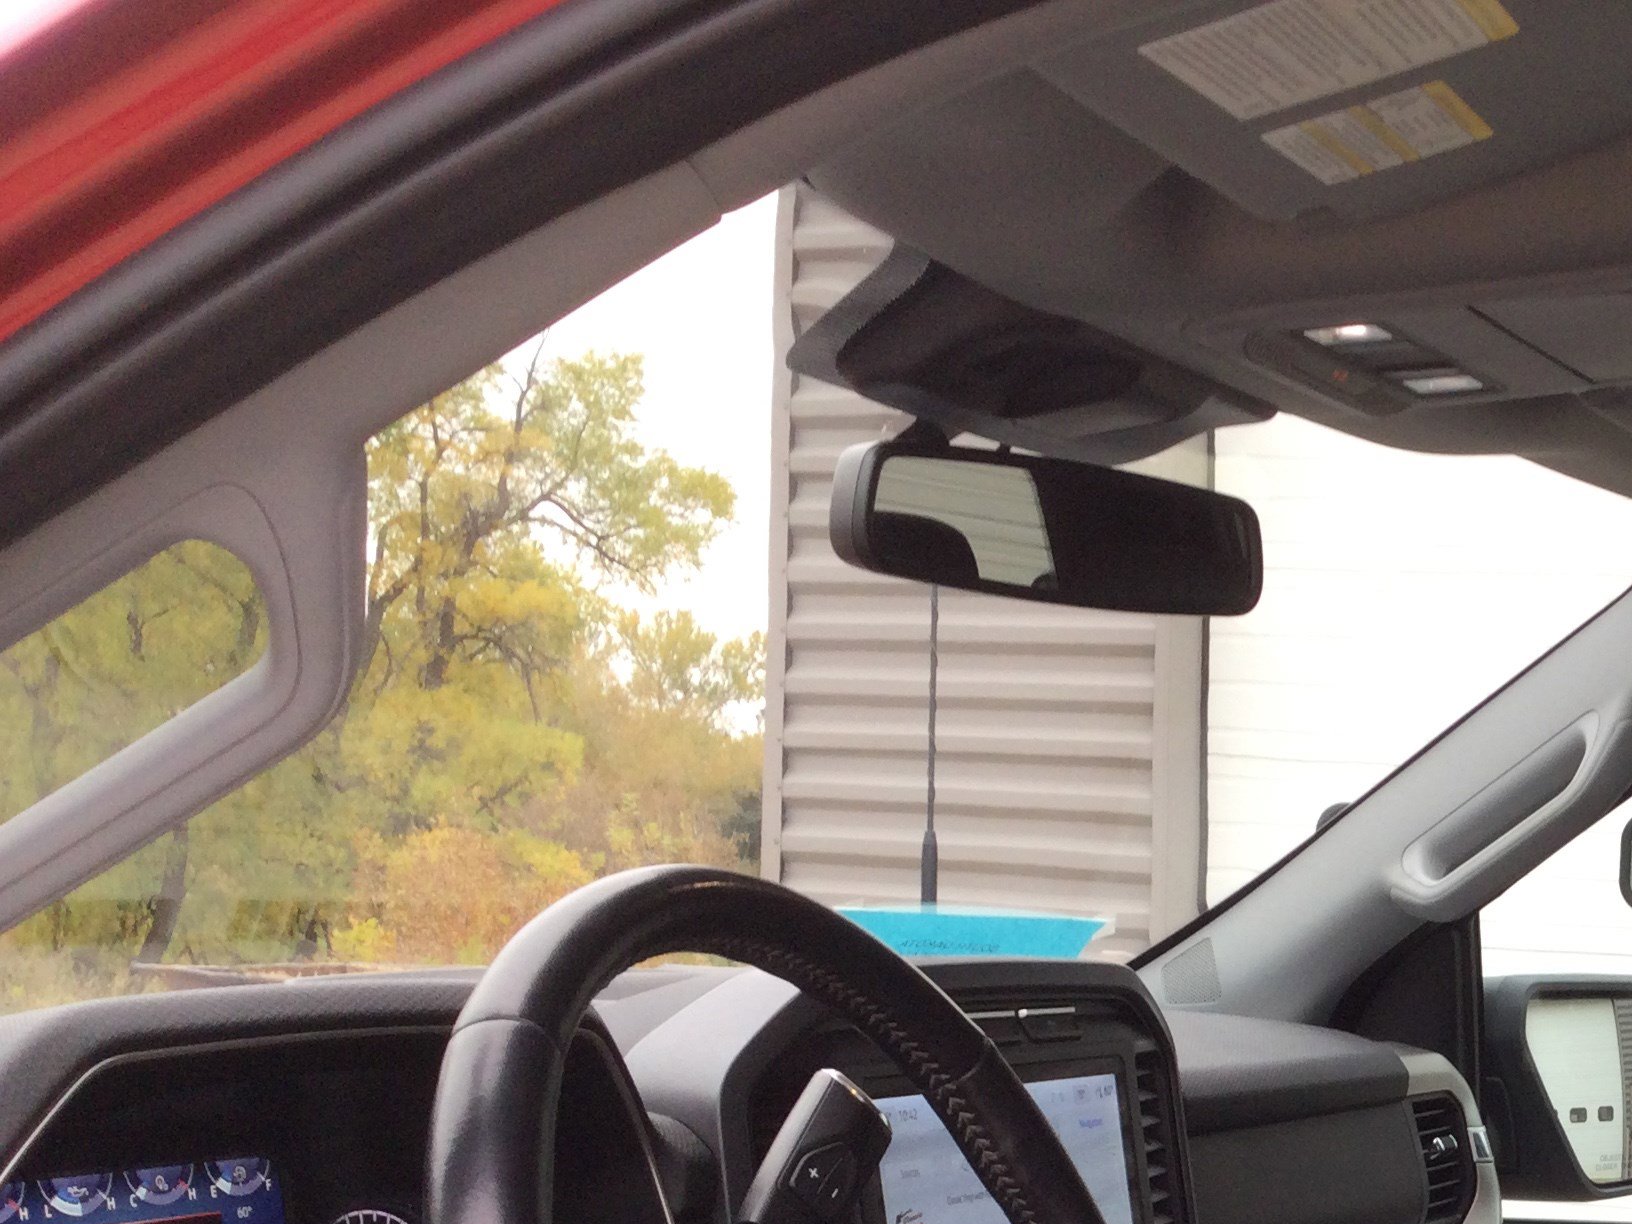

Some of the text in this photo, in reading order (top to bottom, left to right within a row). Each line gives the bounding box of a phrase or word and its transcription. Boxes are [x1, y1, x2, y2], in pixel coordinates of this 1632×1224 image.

[210, 1184, 218, 1199] E
[265, 1178, 272, 1192] F
[130, 1193, 138, 1208] C
[188, 1187, 197, 1200] H
[44, 1204, 53, 1218] L
[107, 1197, 116, 1211] H
[19, 1206, 29, 1221] H
